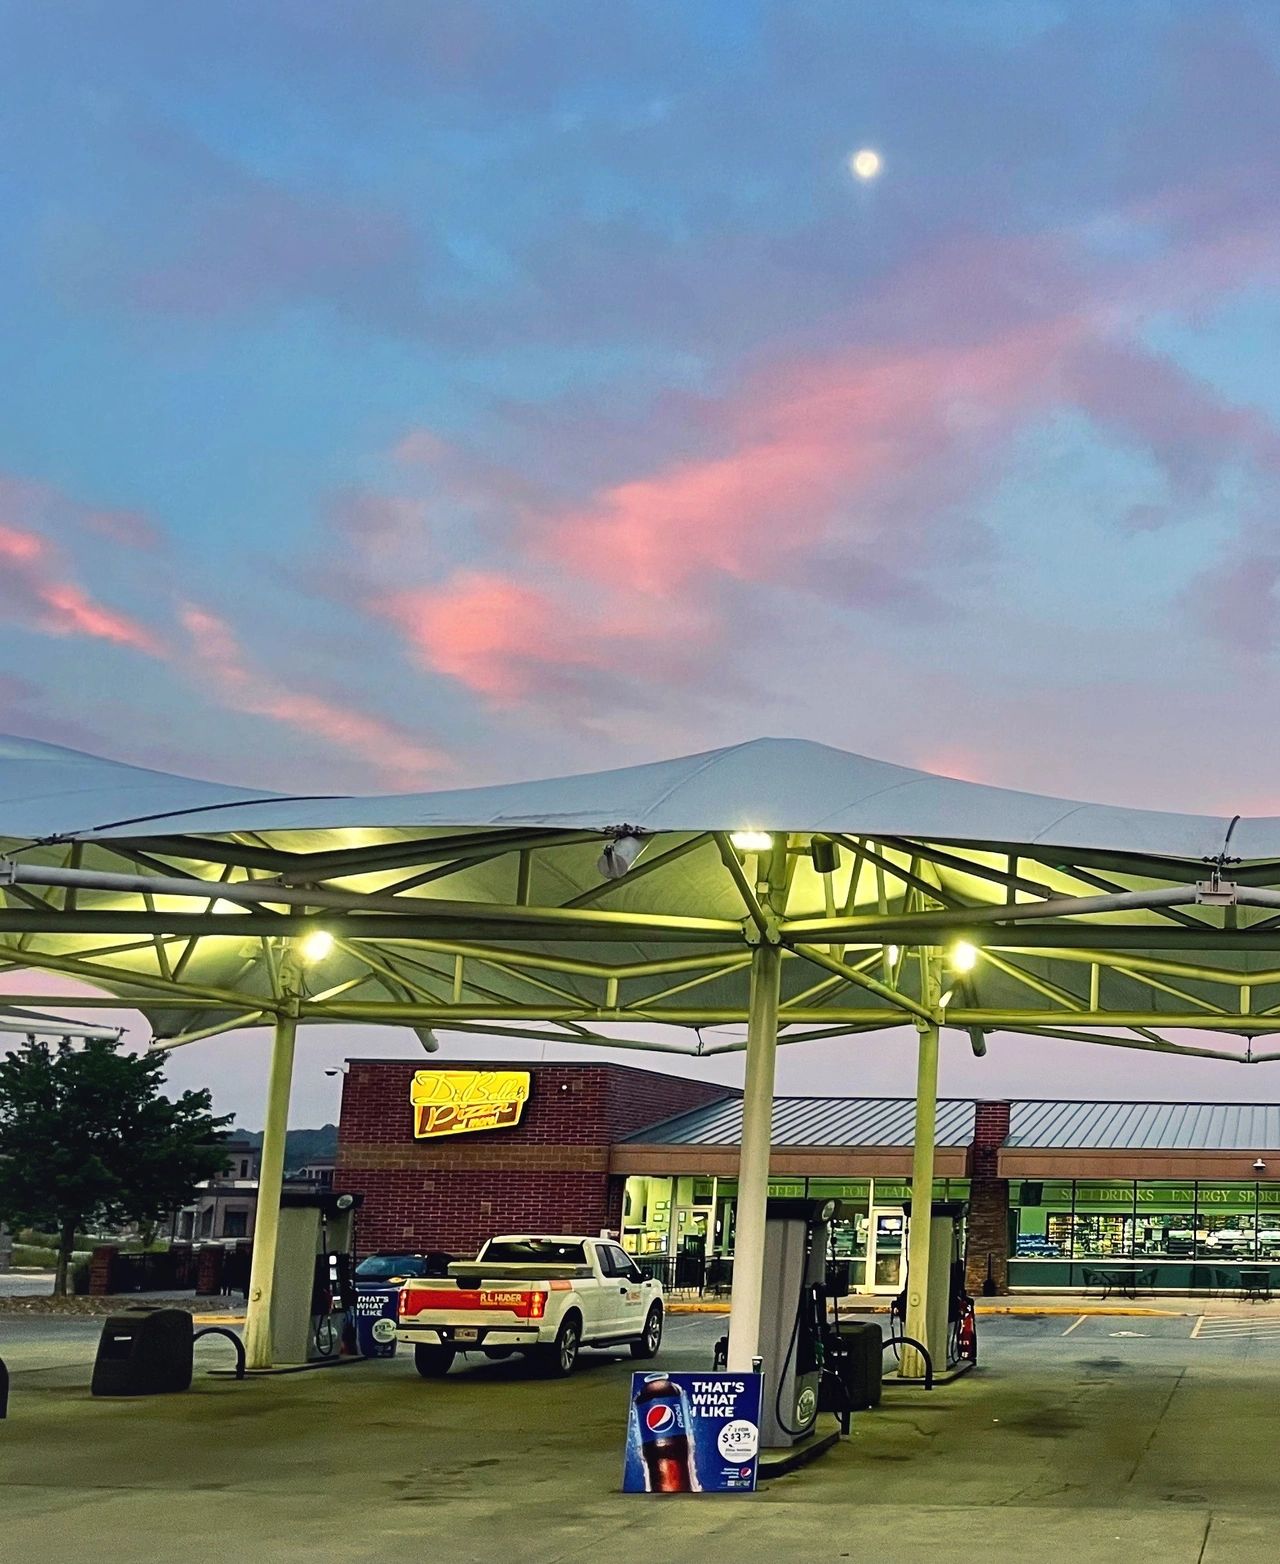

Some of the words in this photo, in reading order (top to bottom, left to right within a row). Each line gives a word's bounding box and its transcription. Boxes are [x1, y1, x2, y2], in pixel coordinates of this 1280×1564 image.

[425, 1102, 512, 1131] Pizza
[842, 1186, 914, 1198] FOUTAIN
[1100, 1189, 1154, 1201] DRINKS
[1171, 1190, 1230, 1202] ENERGY
[361, 1309, 383, 1317] LIKE
[691, 1381, 745, 1393] THAT'S
[691, 1394, 738, 1405] WHAT
[692, 1406, 697, 1417] I
[700, 1406, 735, 1418] LIKE
